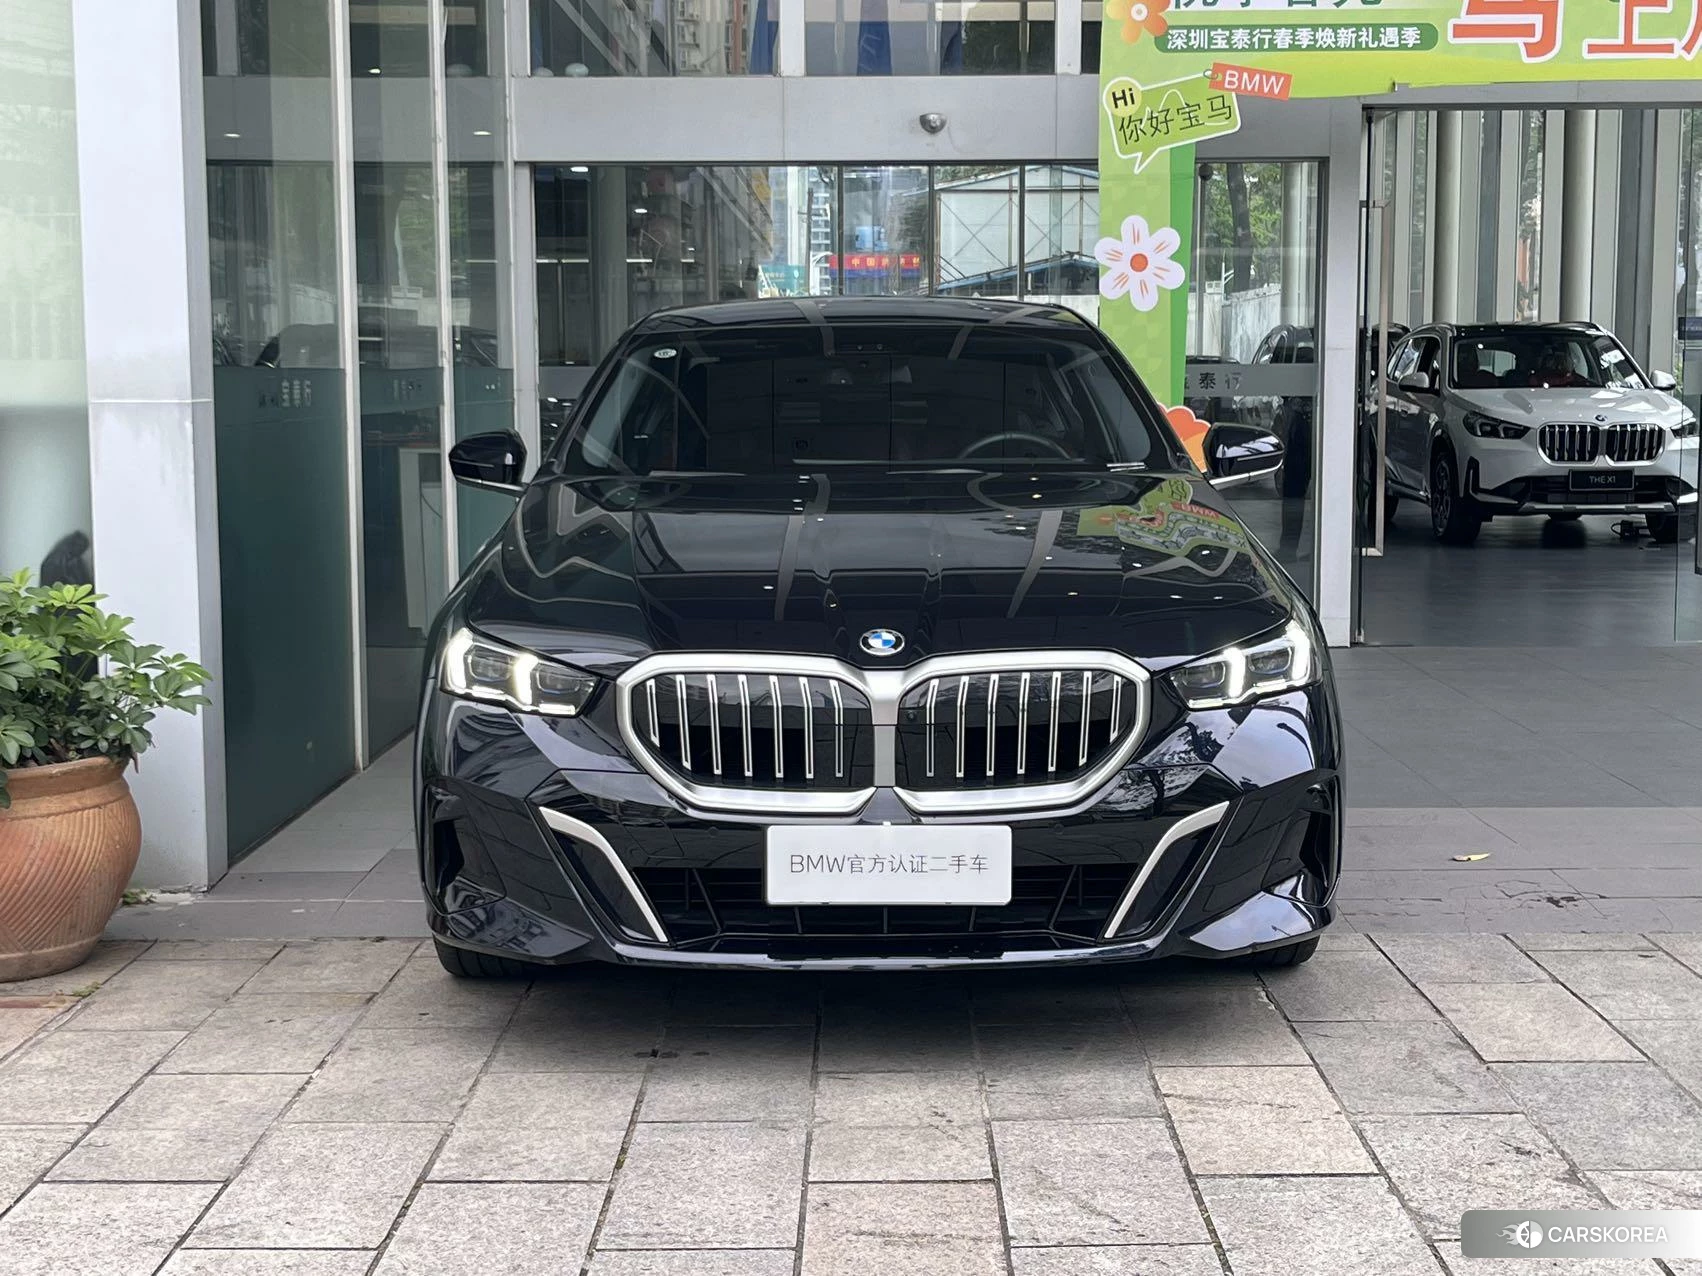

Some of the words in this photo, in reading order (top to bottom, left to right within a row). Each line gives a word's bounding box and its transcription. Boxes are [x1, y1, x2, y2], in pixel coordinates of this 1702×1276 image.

[1167, 26, 1421, 49] 深圳宝泰行春季焕新礼遇季
[1447, 0, 1702, 62] 马上
[1223, 70, 1285, 95] BMW
[1112, 87, 1136, 109] Hi
[1118, 94, 1233, 145] 你好宝马
[1184, 372, 1242, 390] 泰行
[1589, 475, 1606, 484] THE
[1608, 475, 1616, 484] X1
[790, 854, 989, 875] BMW官方认证二手车
